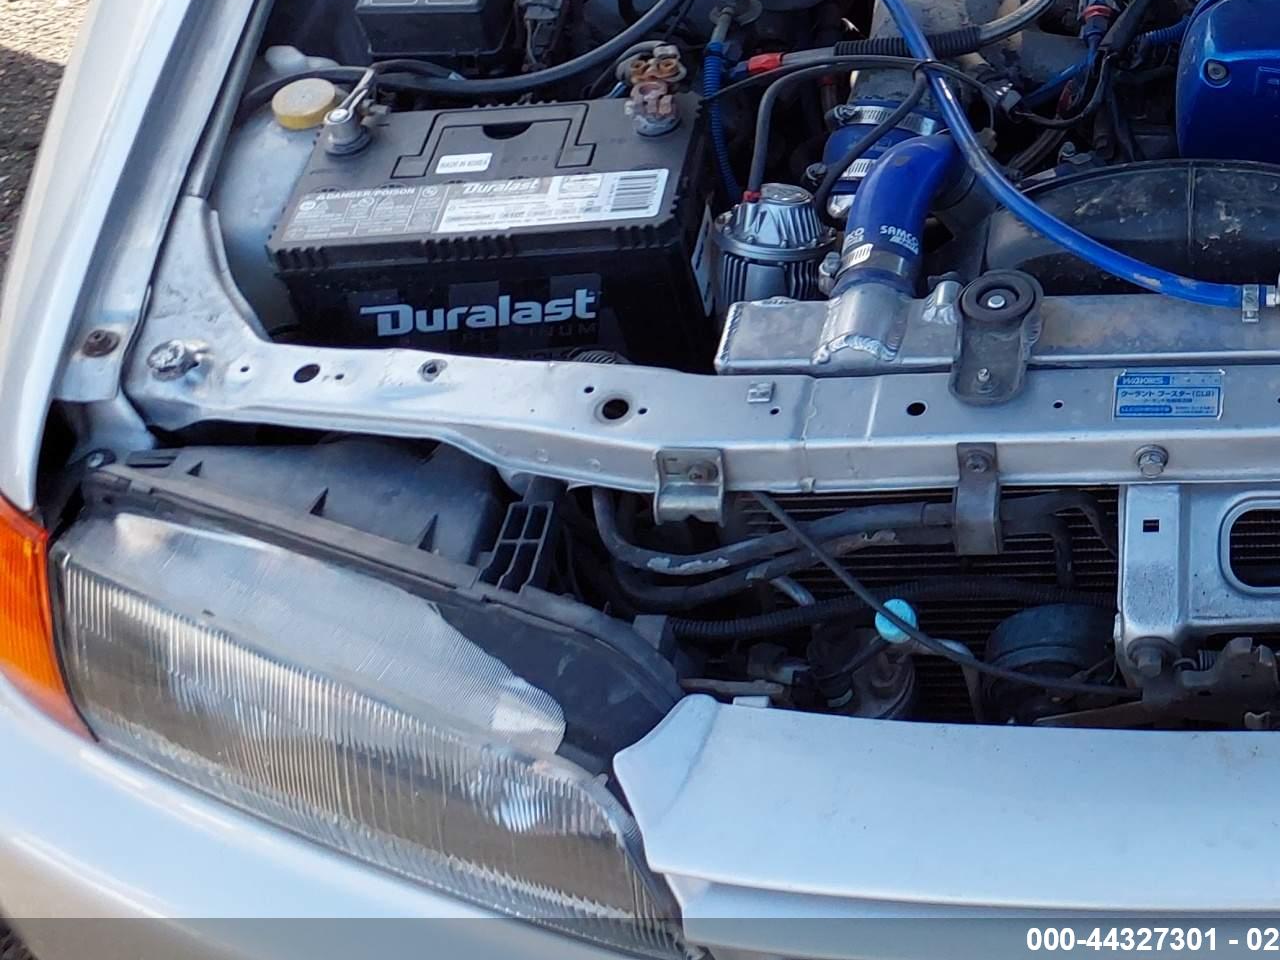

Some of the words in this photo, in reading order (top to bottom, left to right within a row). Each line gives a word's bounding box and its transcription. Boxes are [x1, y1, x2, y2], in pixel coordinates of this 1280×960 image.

[462, 178, 541, 194] Duralast
[880, 225, 919, 246] SAMCO
[360, 288, 597, 337] Duralast
